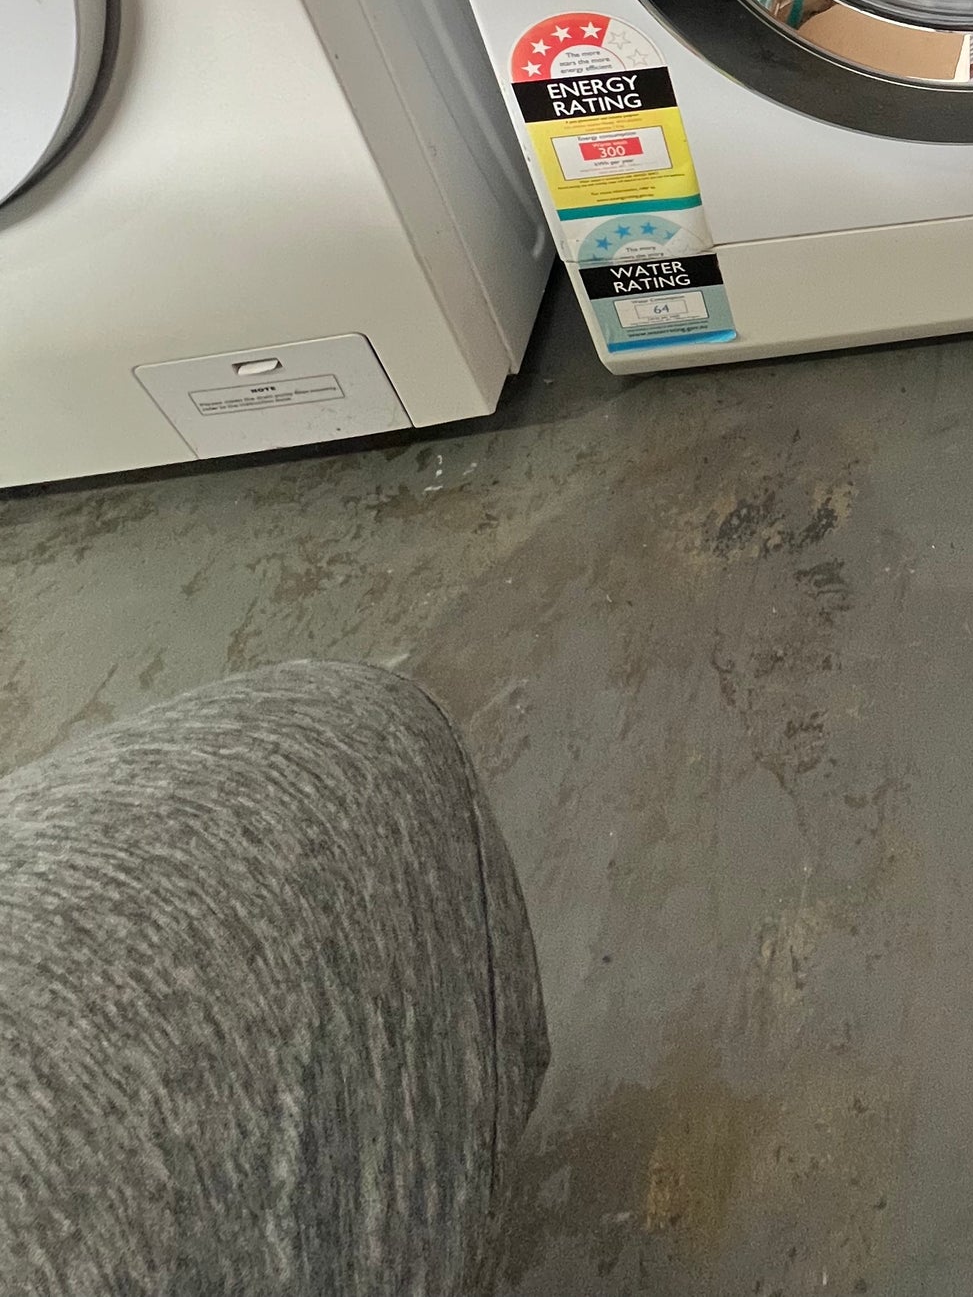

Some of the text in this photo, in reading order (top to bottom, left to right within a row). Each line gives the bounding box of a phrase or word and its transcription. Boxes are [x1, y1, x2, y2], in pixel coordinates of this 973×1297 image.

[547, 75, 637, 99] ENERGY
[552, 93, 642, 116] RATING
[599, 146, 625, 158] 300
[610, 261, 686, 279] WATER
[613, 274, 691, 293] RATING
[653, 304, 670, 314] 64
